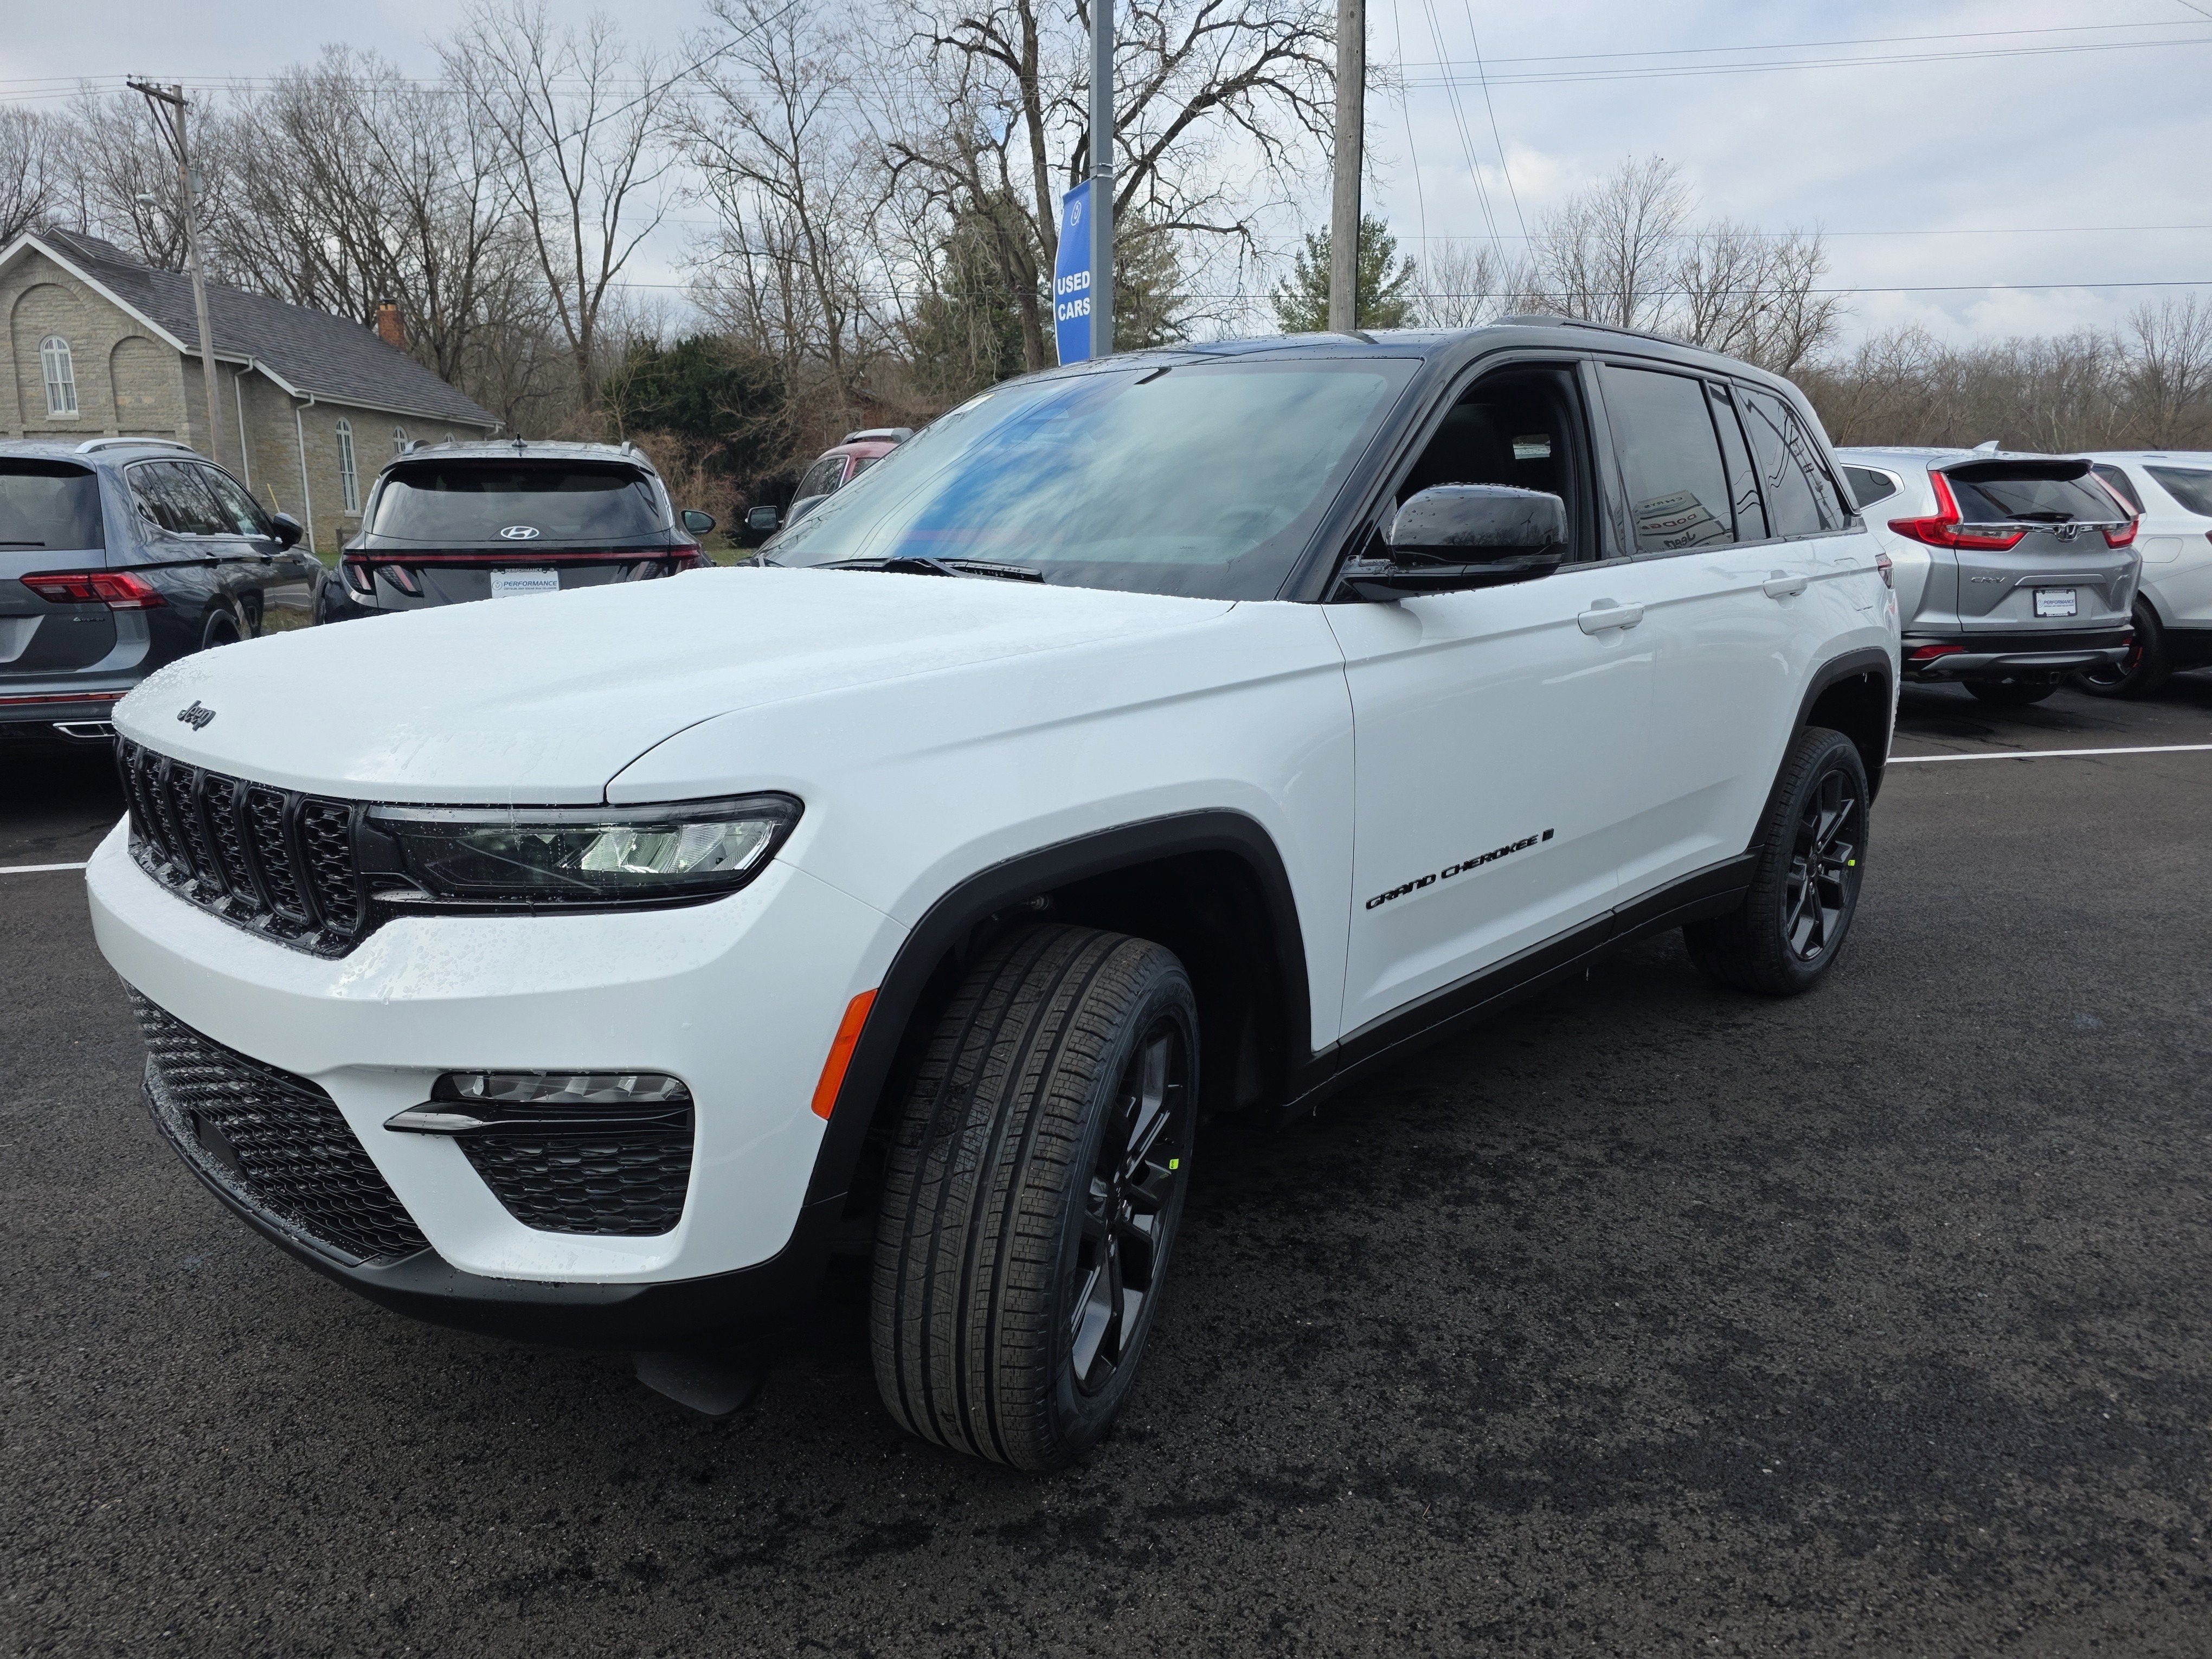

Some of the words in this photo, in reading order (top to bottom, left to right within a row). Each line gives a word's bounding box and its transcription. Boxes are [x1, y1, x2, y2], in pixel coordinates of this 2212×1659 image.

[1058, 271, 1090, 295] USED
[1058, 297, 1090, 321] CARS
[177, 700, 216, 731] Jeep
[1366, 873, 1437, 910] GRAND
[1441, 834, 1539, 879] CHEROKEE
